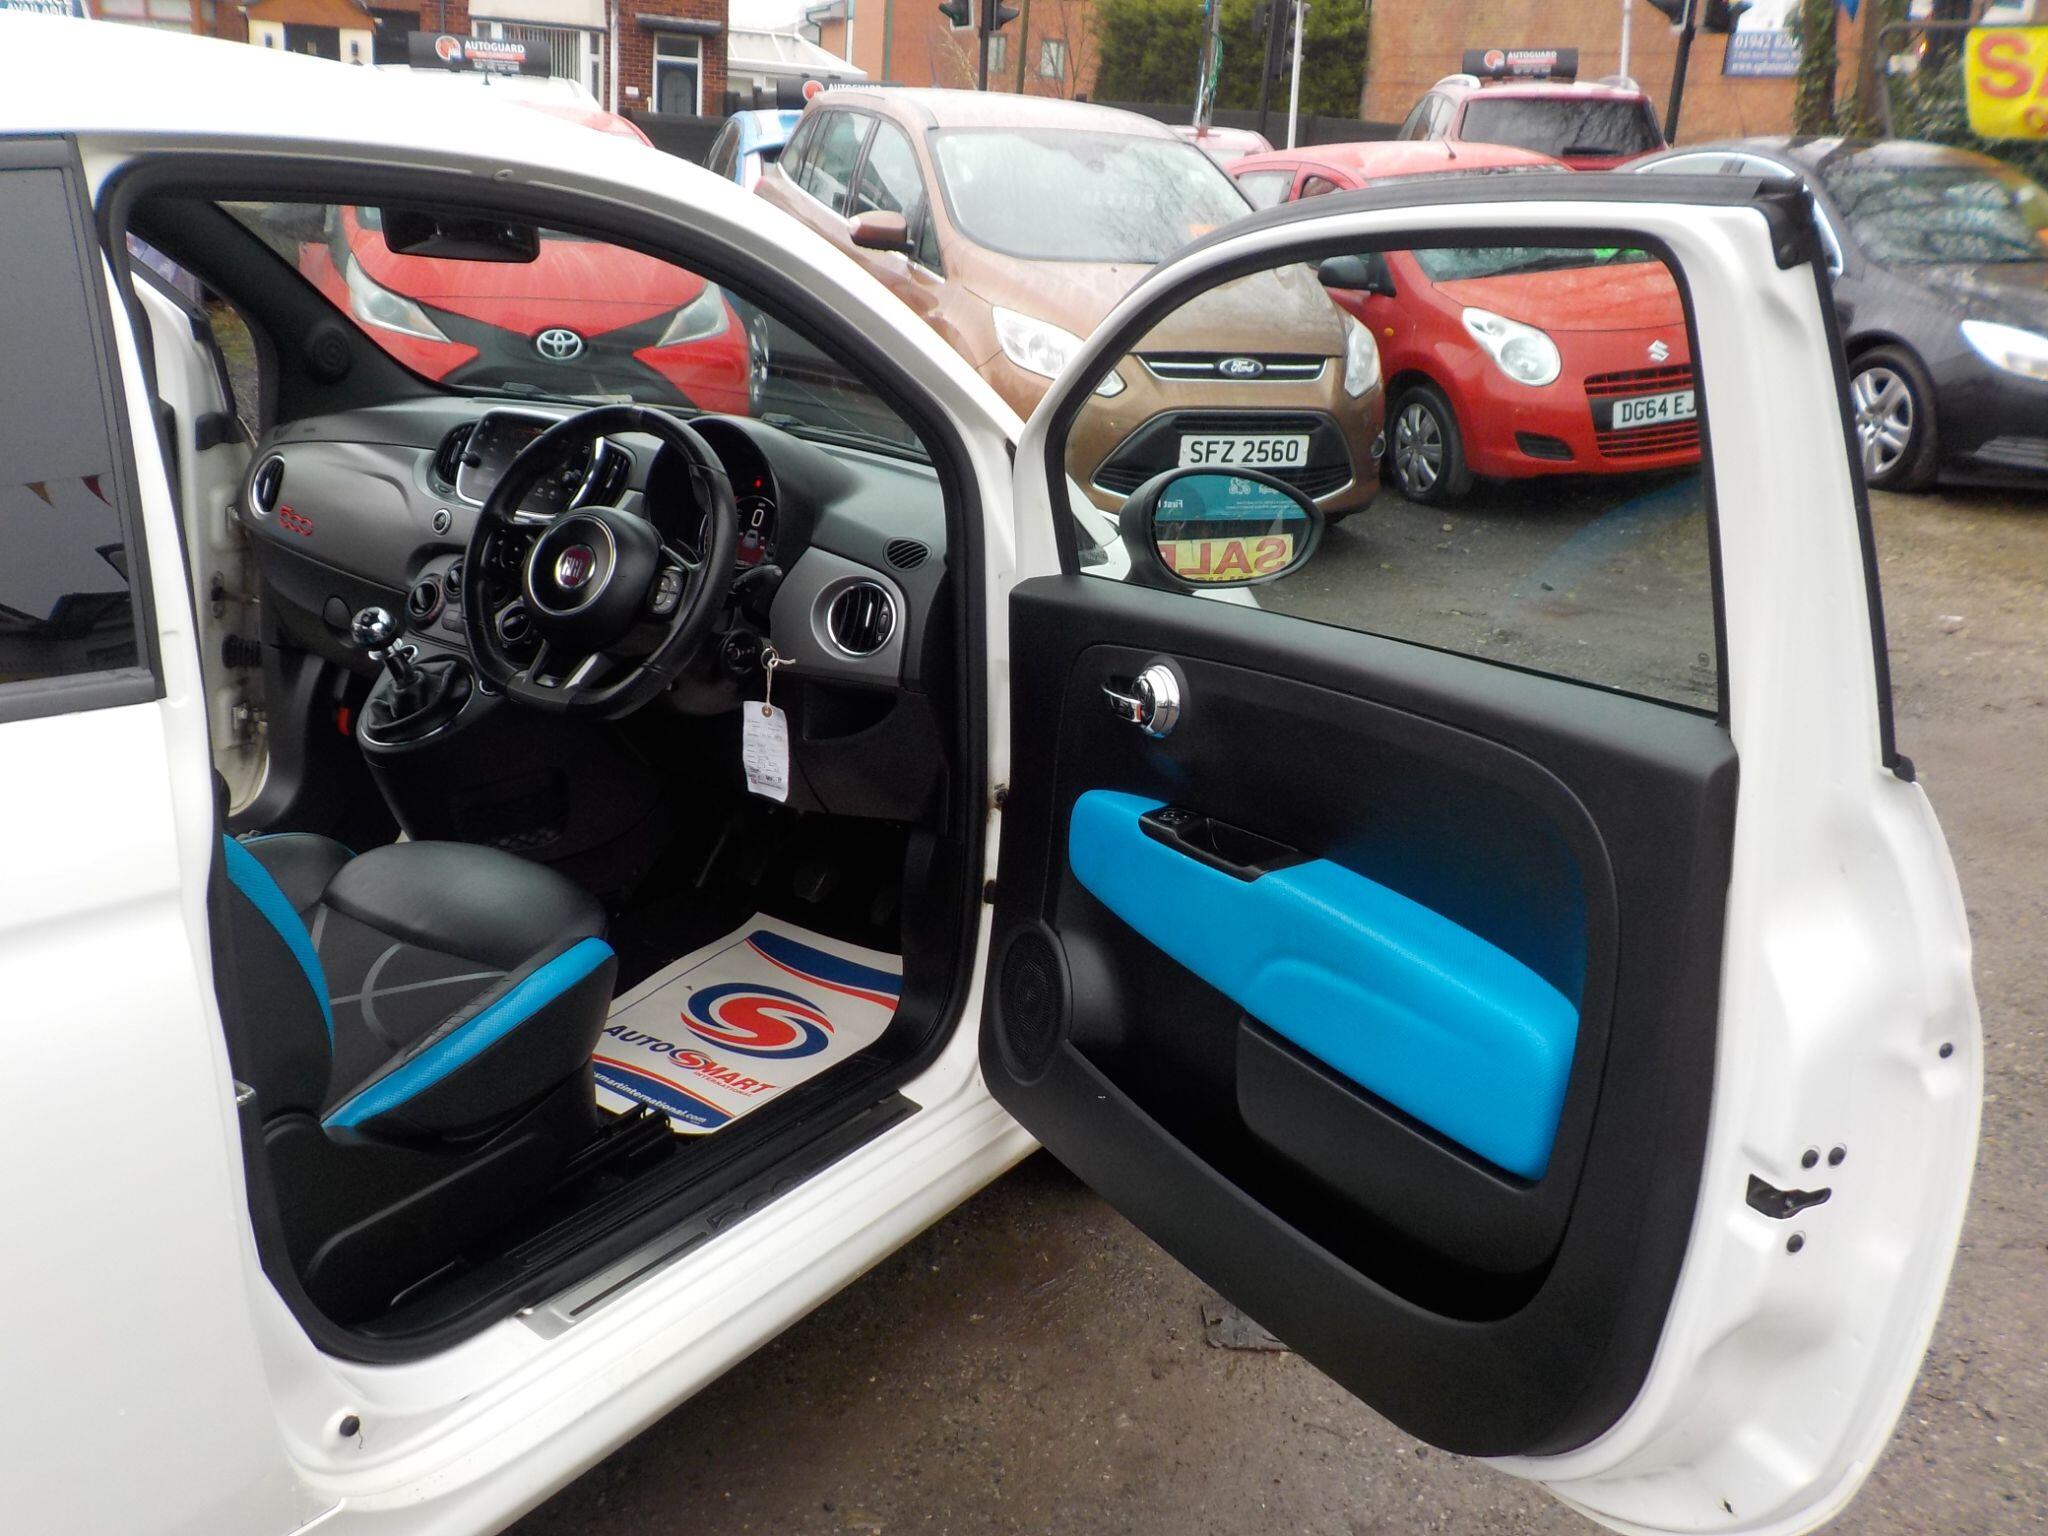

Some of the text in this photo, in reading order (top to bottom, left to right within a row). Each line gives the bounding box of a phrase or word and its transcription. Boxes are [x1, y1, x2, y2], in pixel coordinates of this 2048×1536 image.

[464, 40, 525, 53] AUTOGUARD
[1507, 50, 1558, 58] AUTOGUARD
[1979, 32, 2048, 98] S
[1231, 359, 1255, 373] Ford
[1622, 398, 1668, 423] DG64
[1190, 439, 1299, 464] SFZ 2560
